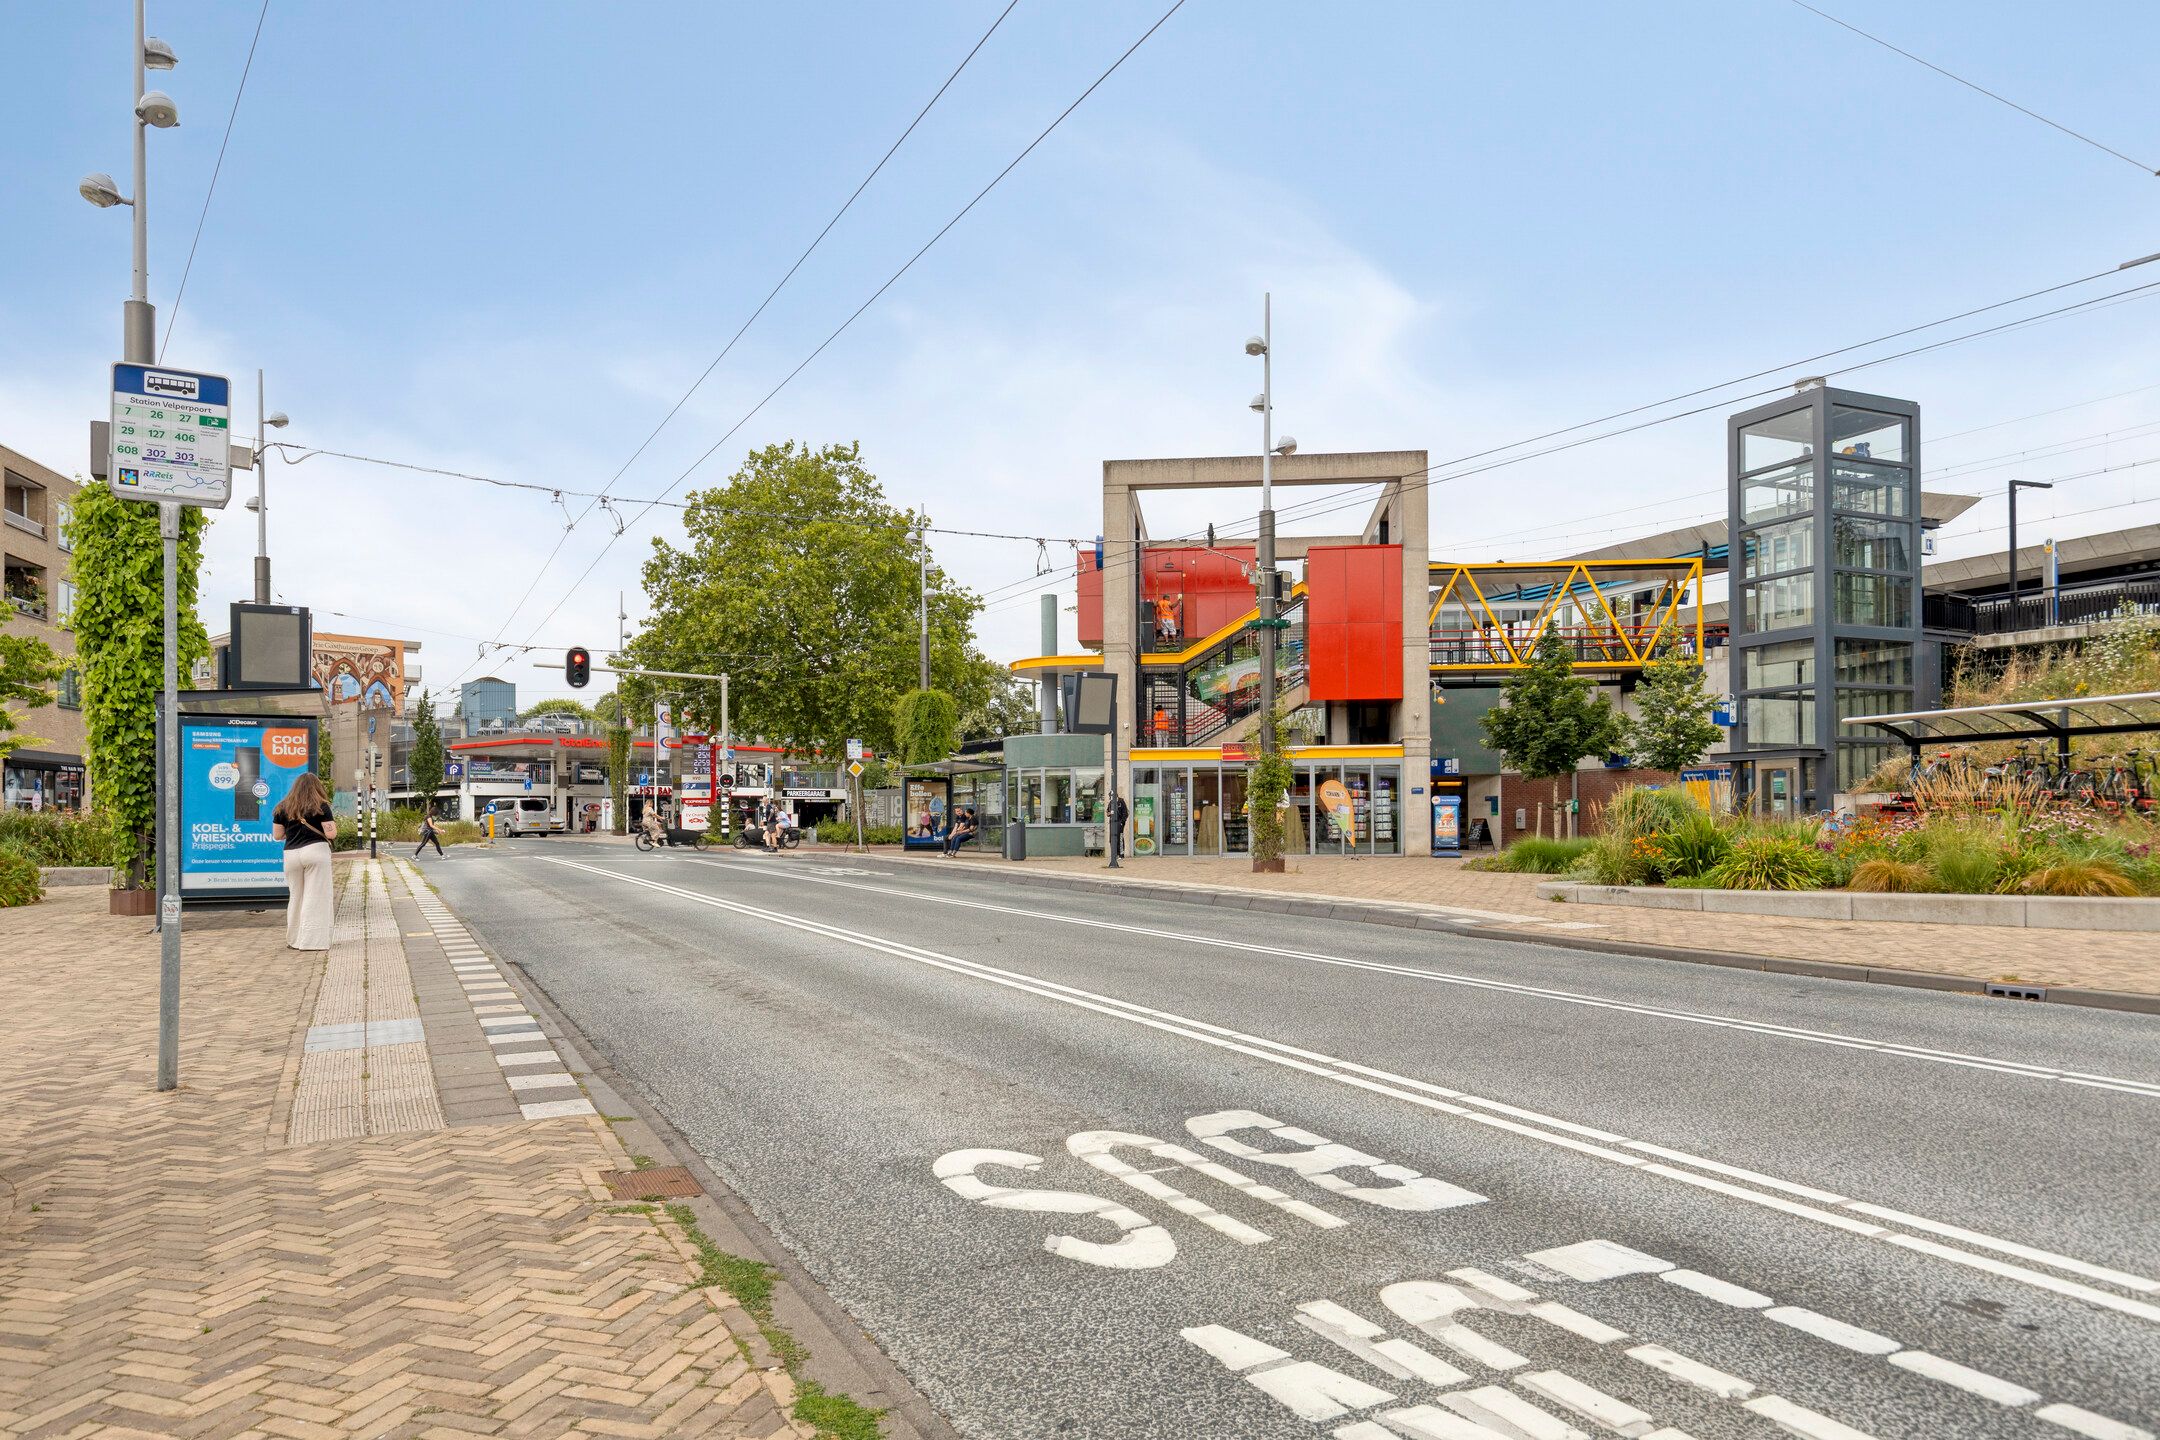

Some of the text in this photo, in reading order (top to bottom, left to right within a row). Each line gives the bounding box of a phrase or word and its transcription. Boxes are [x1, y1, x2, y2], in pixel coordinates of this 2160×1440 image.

[130, 396, 212, 414] Station Velperpoort
[124, 406, 192, 423] 7 26 27
[121, 426, 135, 435] 29
[148, 429, 165, 439] 127
[174, 433, 196, 442] 406
[117, 445, 195, 462] 608 302 303
[143, 470, 174, 480] RRReis
[271, 734, 307, 744] cool
[271, 744, 307, 756] blue
[191, 823, 242, 833] KOEL- &
[931, 1108, 1489, 1270] BUS
